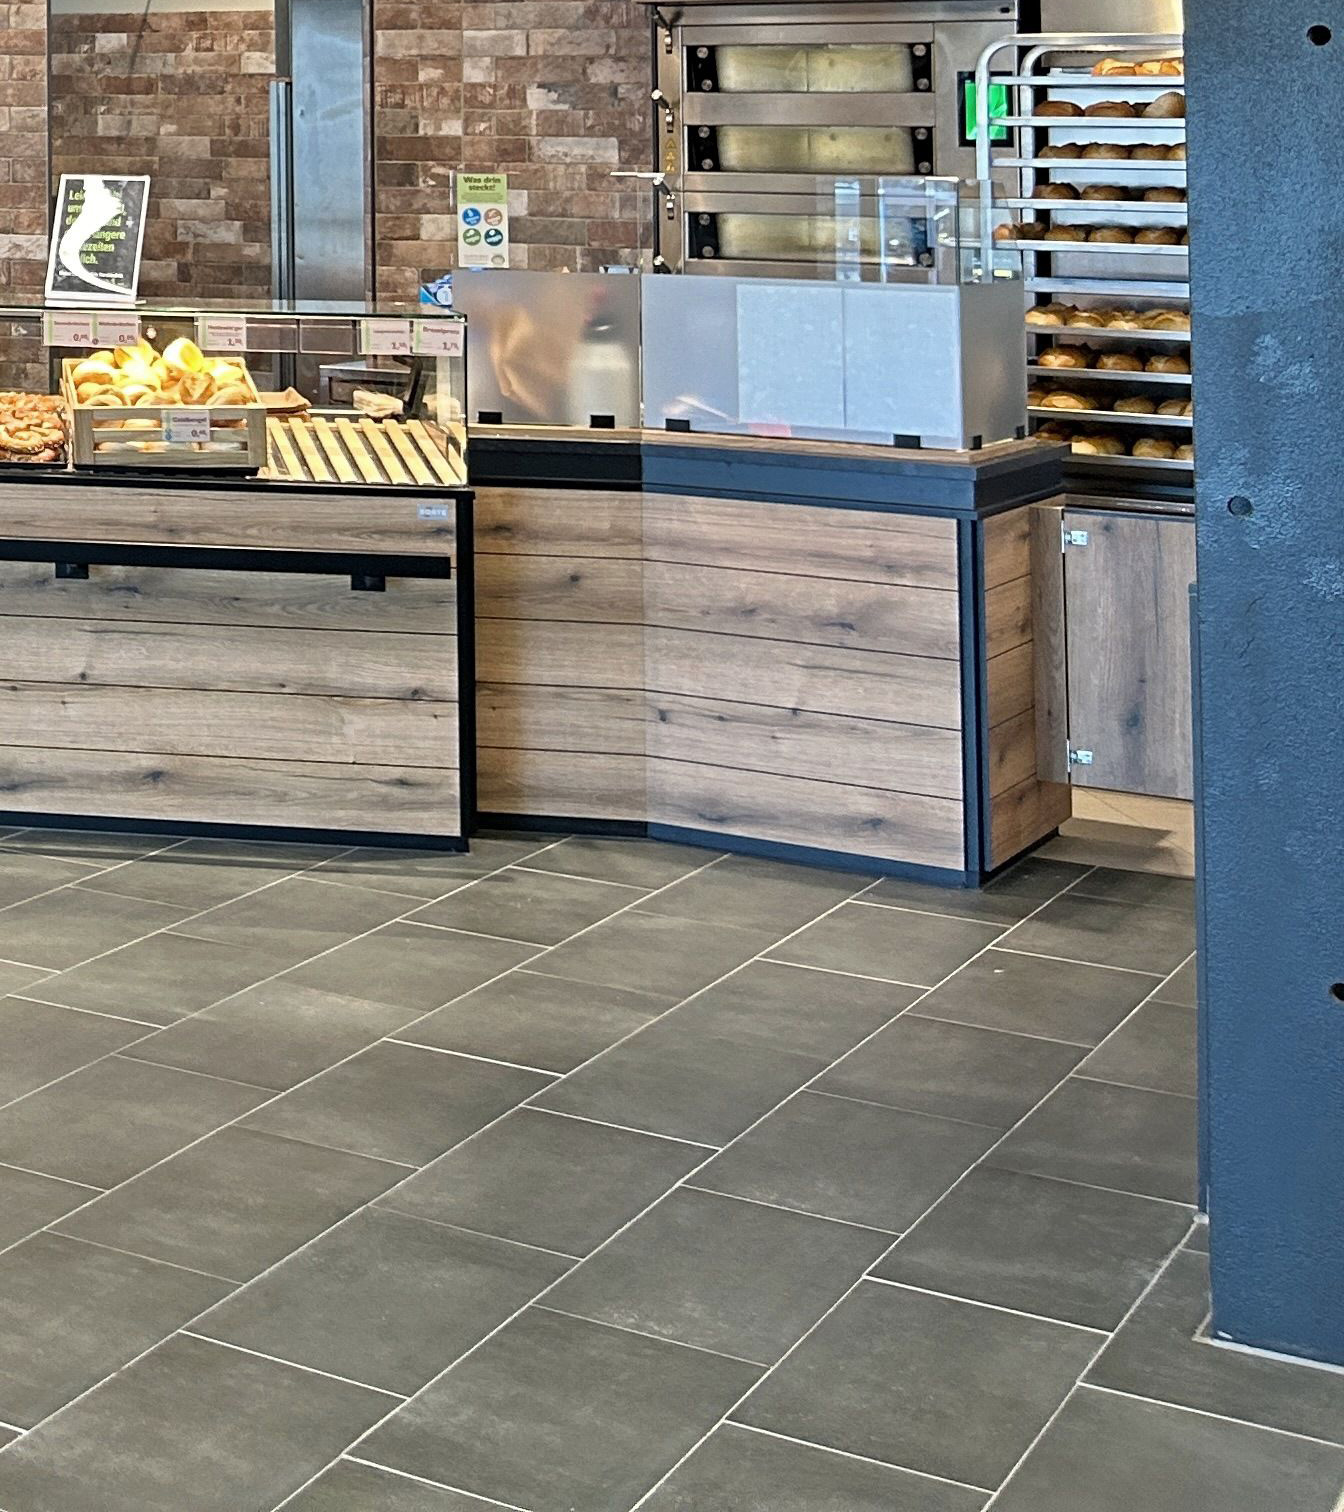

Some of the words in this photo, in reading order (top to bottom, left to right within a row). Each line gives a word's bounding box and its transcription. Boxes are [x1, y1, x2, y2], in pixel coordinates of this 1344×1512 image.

[463, 176, 482, 184] Was
[484, 175, 501, 184] drin
[469, 184, 496, 192] steckt!
